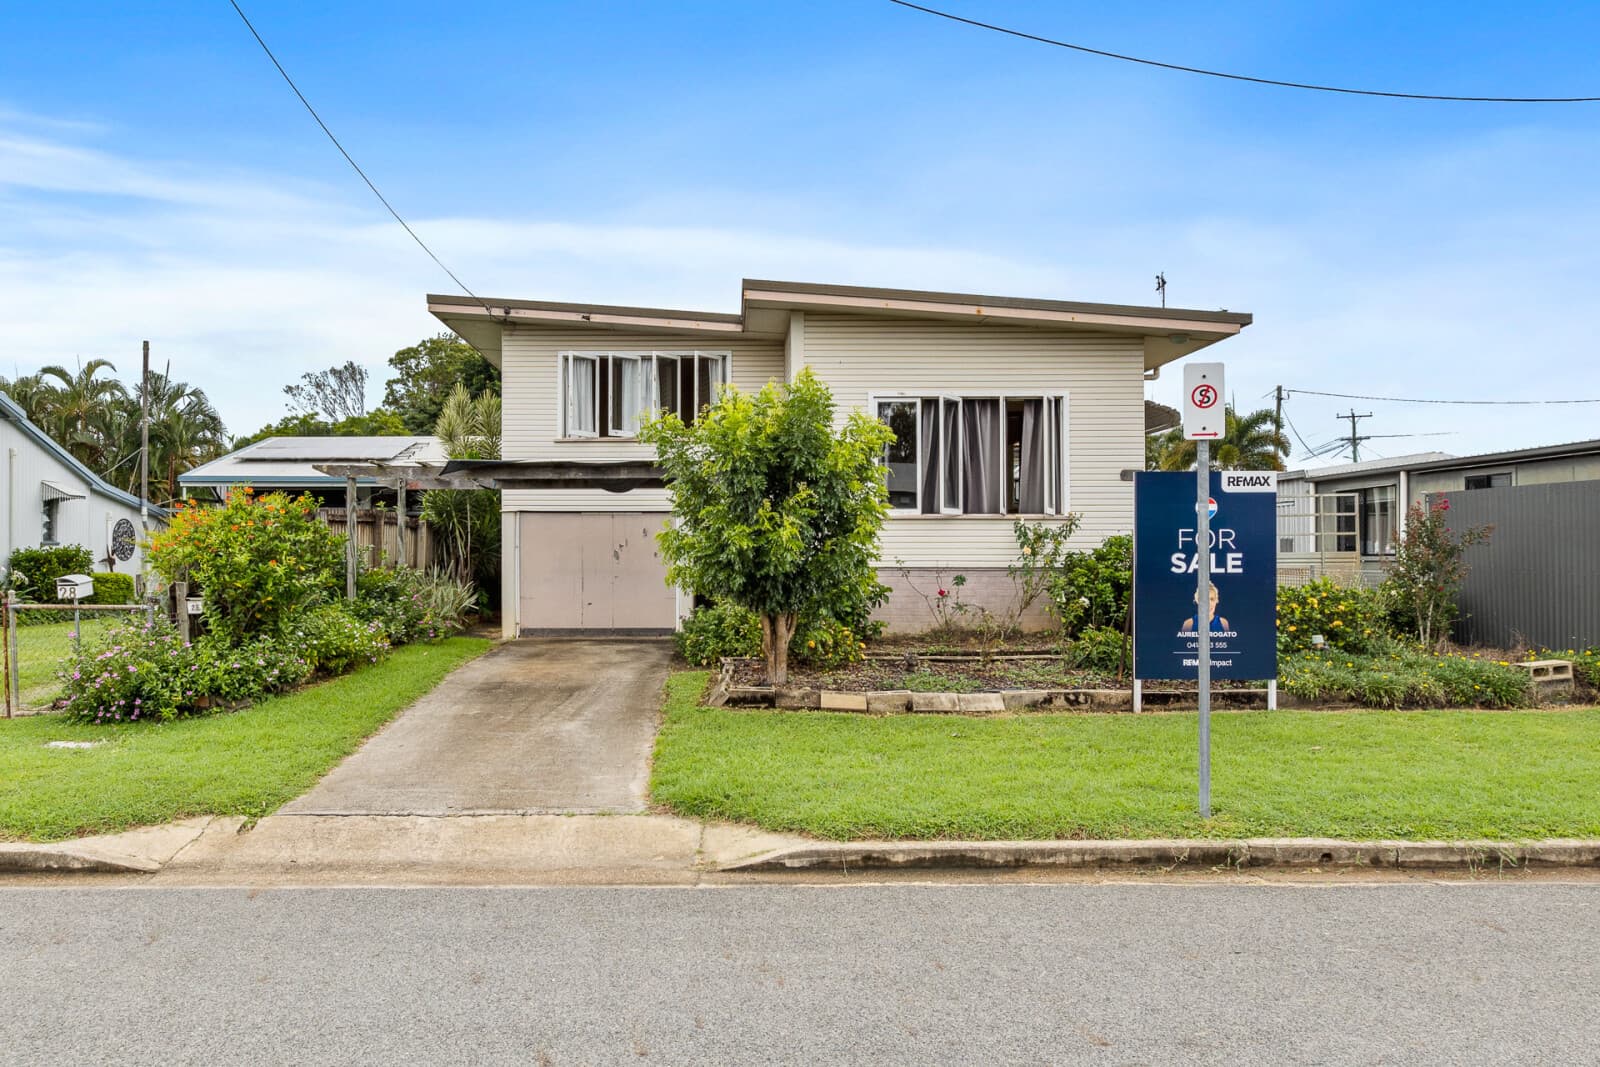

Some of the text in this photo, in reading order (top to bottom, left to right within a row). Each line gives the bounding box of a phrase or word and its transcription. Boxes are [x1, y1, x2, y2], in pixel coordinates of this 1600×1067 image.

[1227, 476, 1271, 487] REMAX
[1178, 528, 1236, 549] FOR
[1170, 552, 1243, 574] SALE
[59, 586, 77, 600] 28
